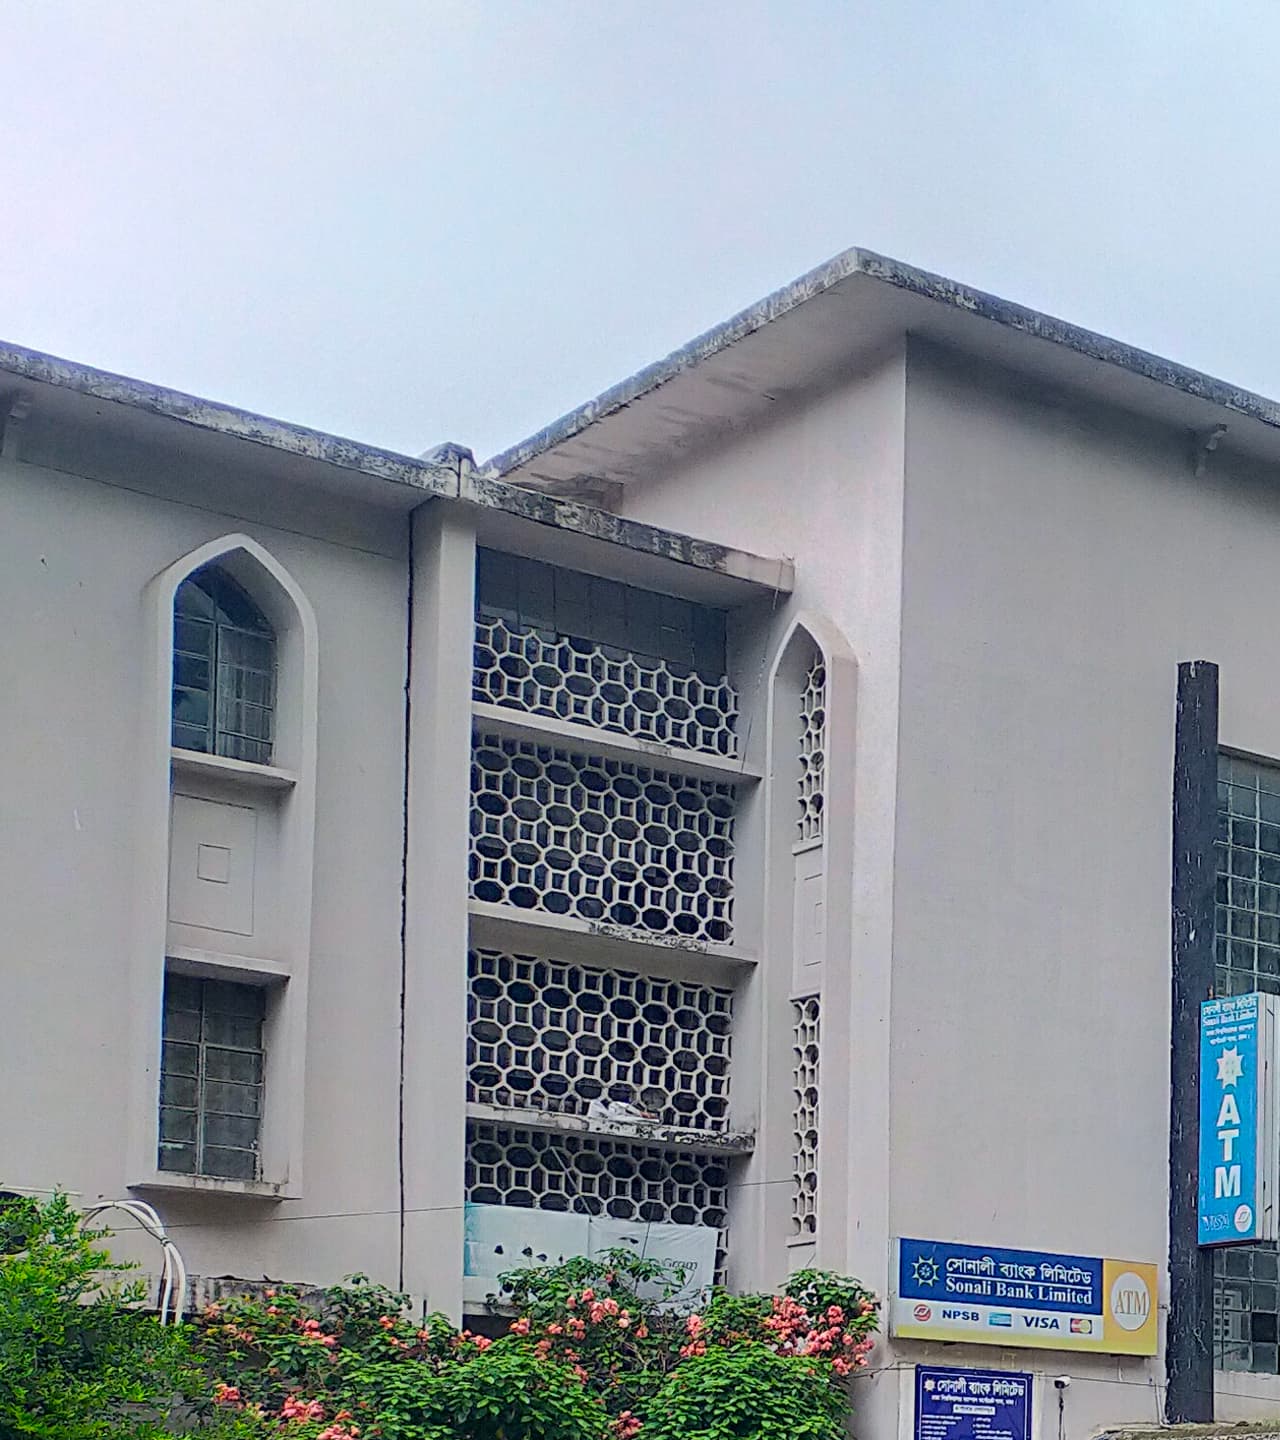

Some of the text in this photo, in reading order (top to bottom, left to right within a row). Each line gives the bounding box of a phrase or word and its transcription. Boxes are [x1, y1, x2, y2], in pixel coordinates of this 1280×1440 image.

[1216, 1094, 1241, 1199] ATM
[946, 1256, 1092, 1285] সোনালী ব্যাংক লিমিটেড
[945, 1277, 1093, 1305] Sonali Bank Limited
[1114, 1290, 1148, 1317] ATM
[941, 1309, 980, 1322] NPSB
[1022, 1315, 1061, 1330] VISA
